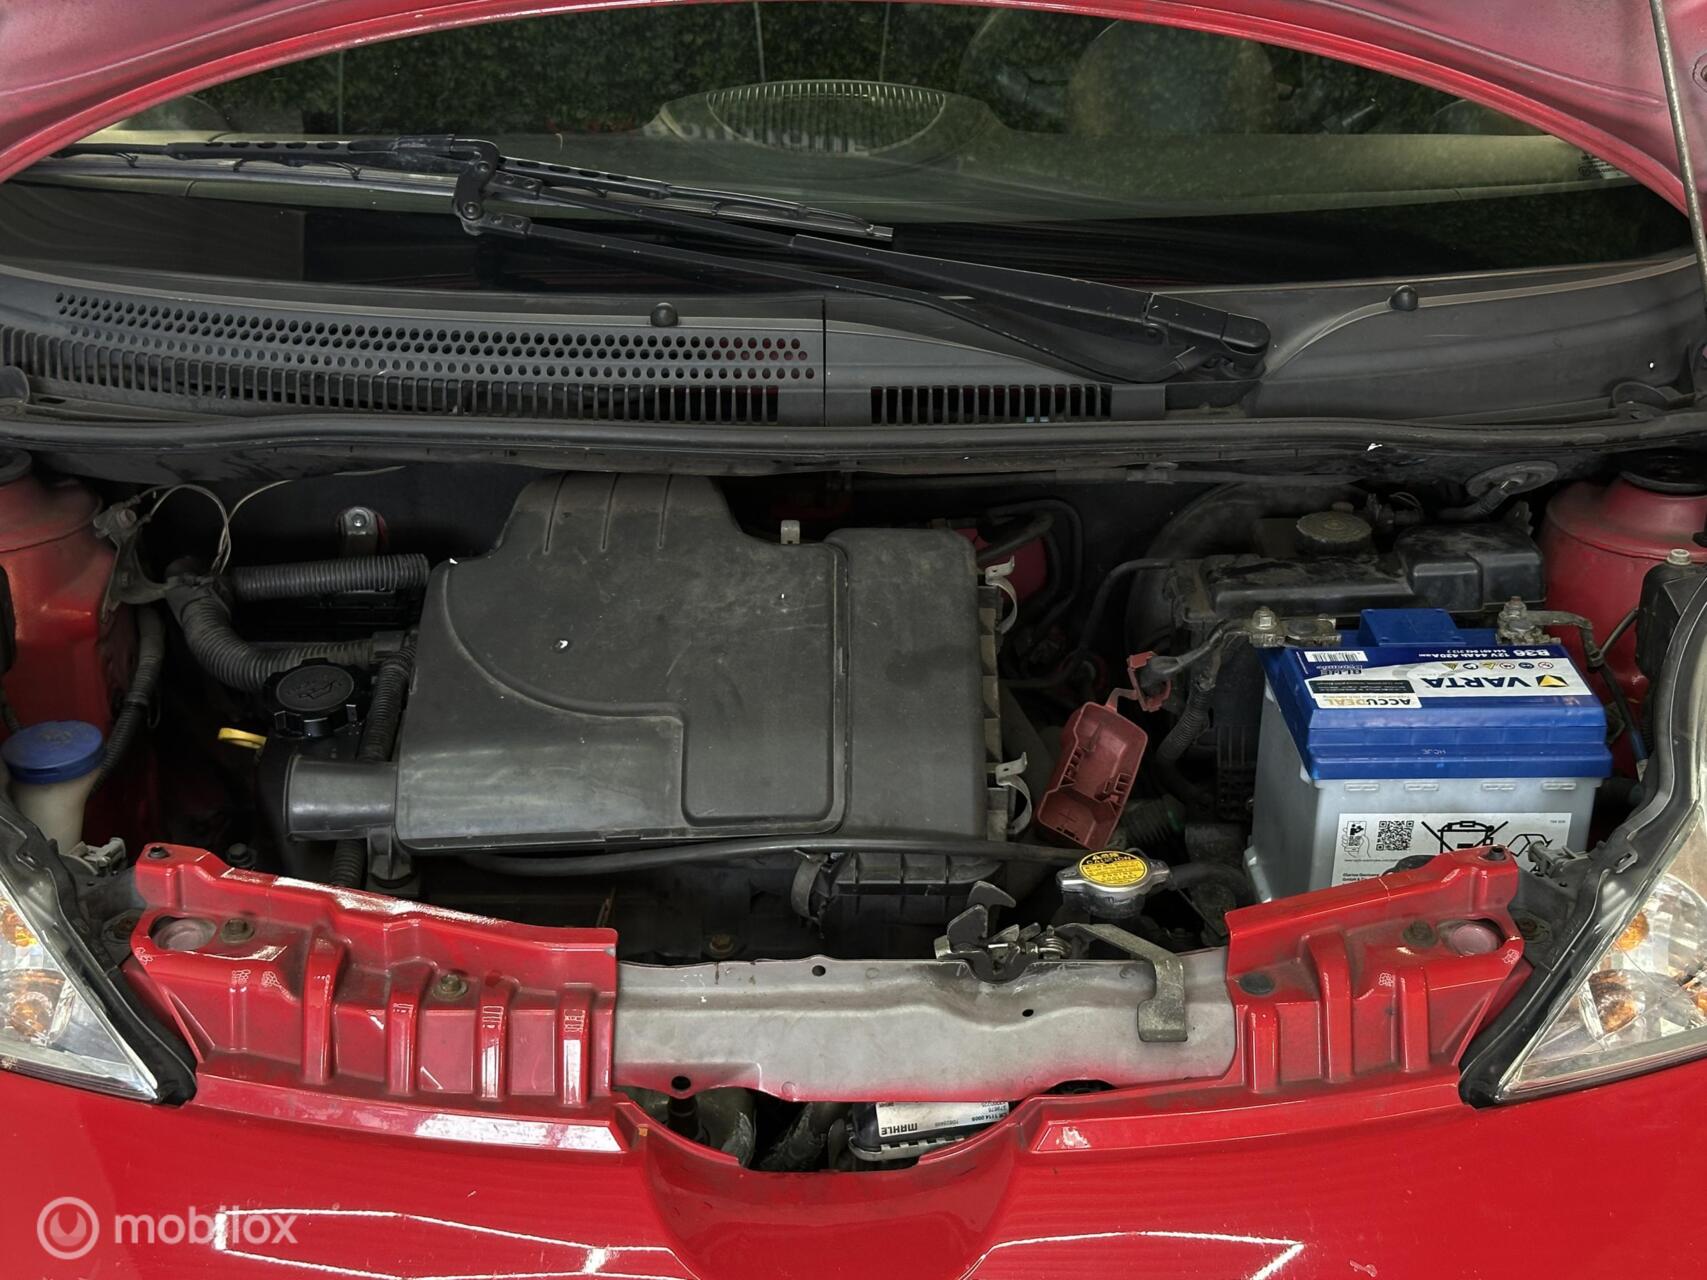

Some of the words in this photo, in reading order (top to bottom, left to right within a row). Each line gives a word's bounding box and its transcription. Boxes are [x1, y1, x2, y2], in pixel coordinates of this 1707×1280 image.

[1513, 649, 1551, 657] B36
[1422, 677, 1532, 688] VARTA
[1324, 697, 1411, 706] ACCUDEAL
[881, 1122, 918, 1135] MAHLE
